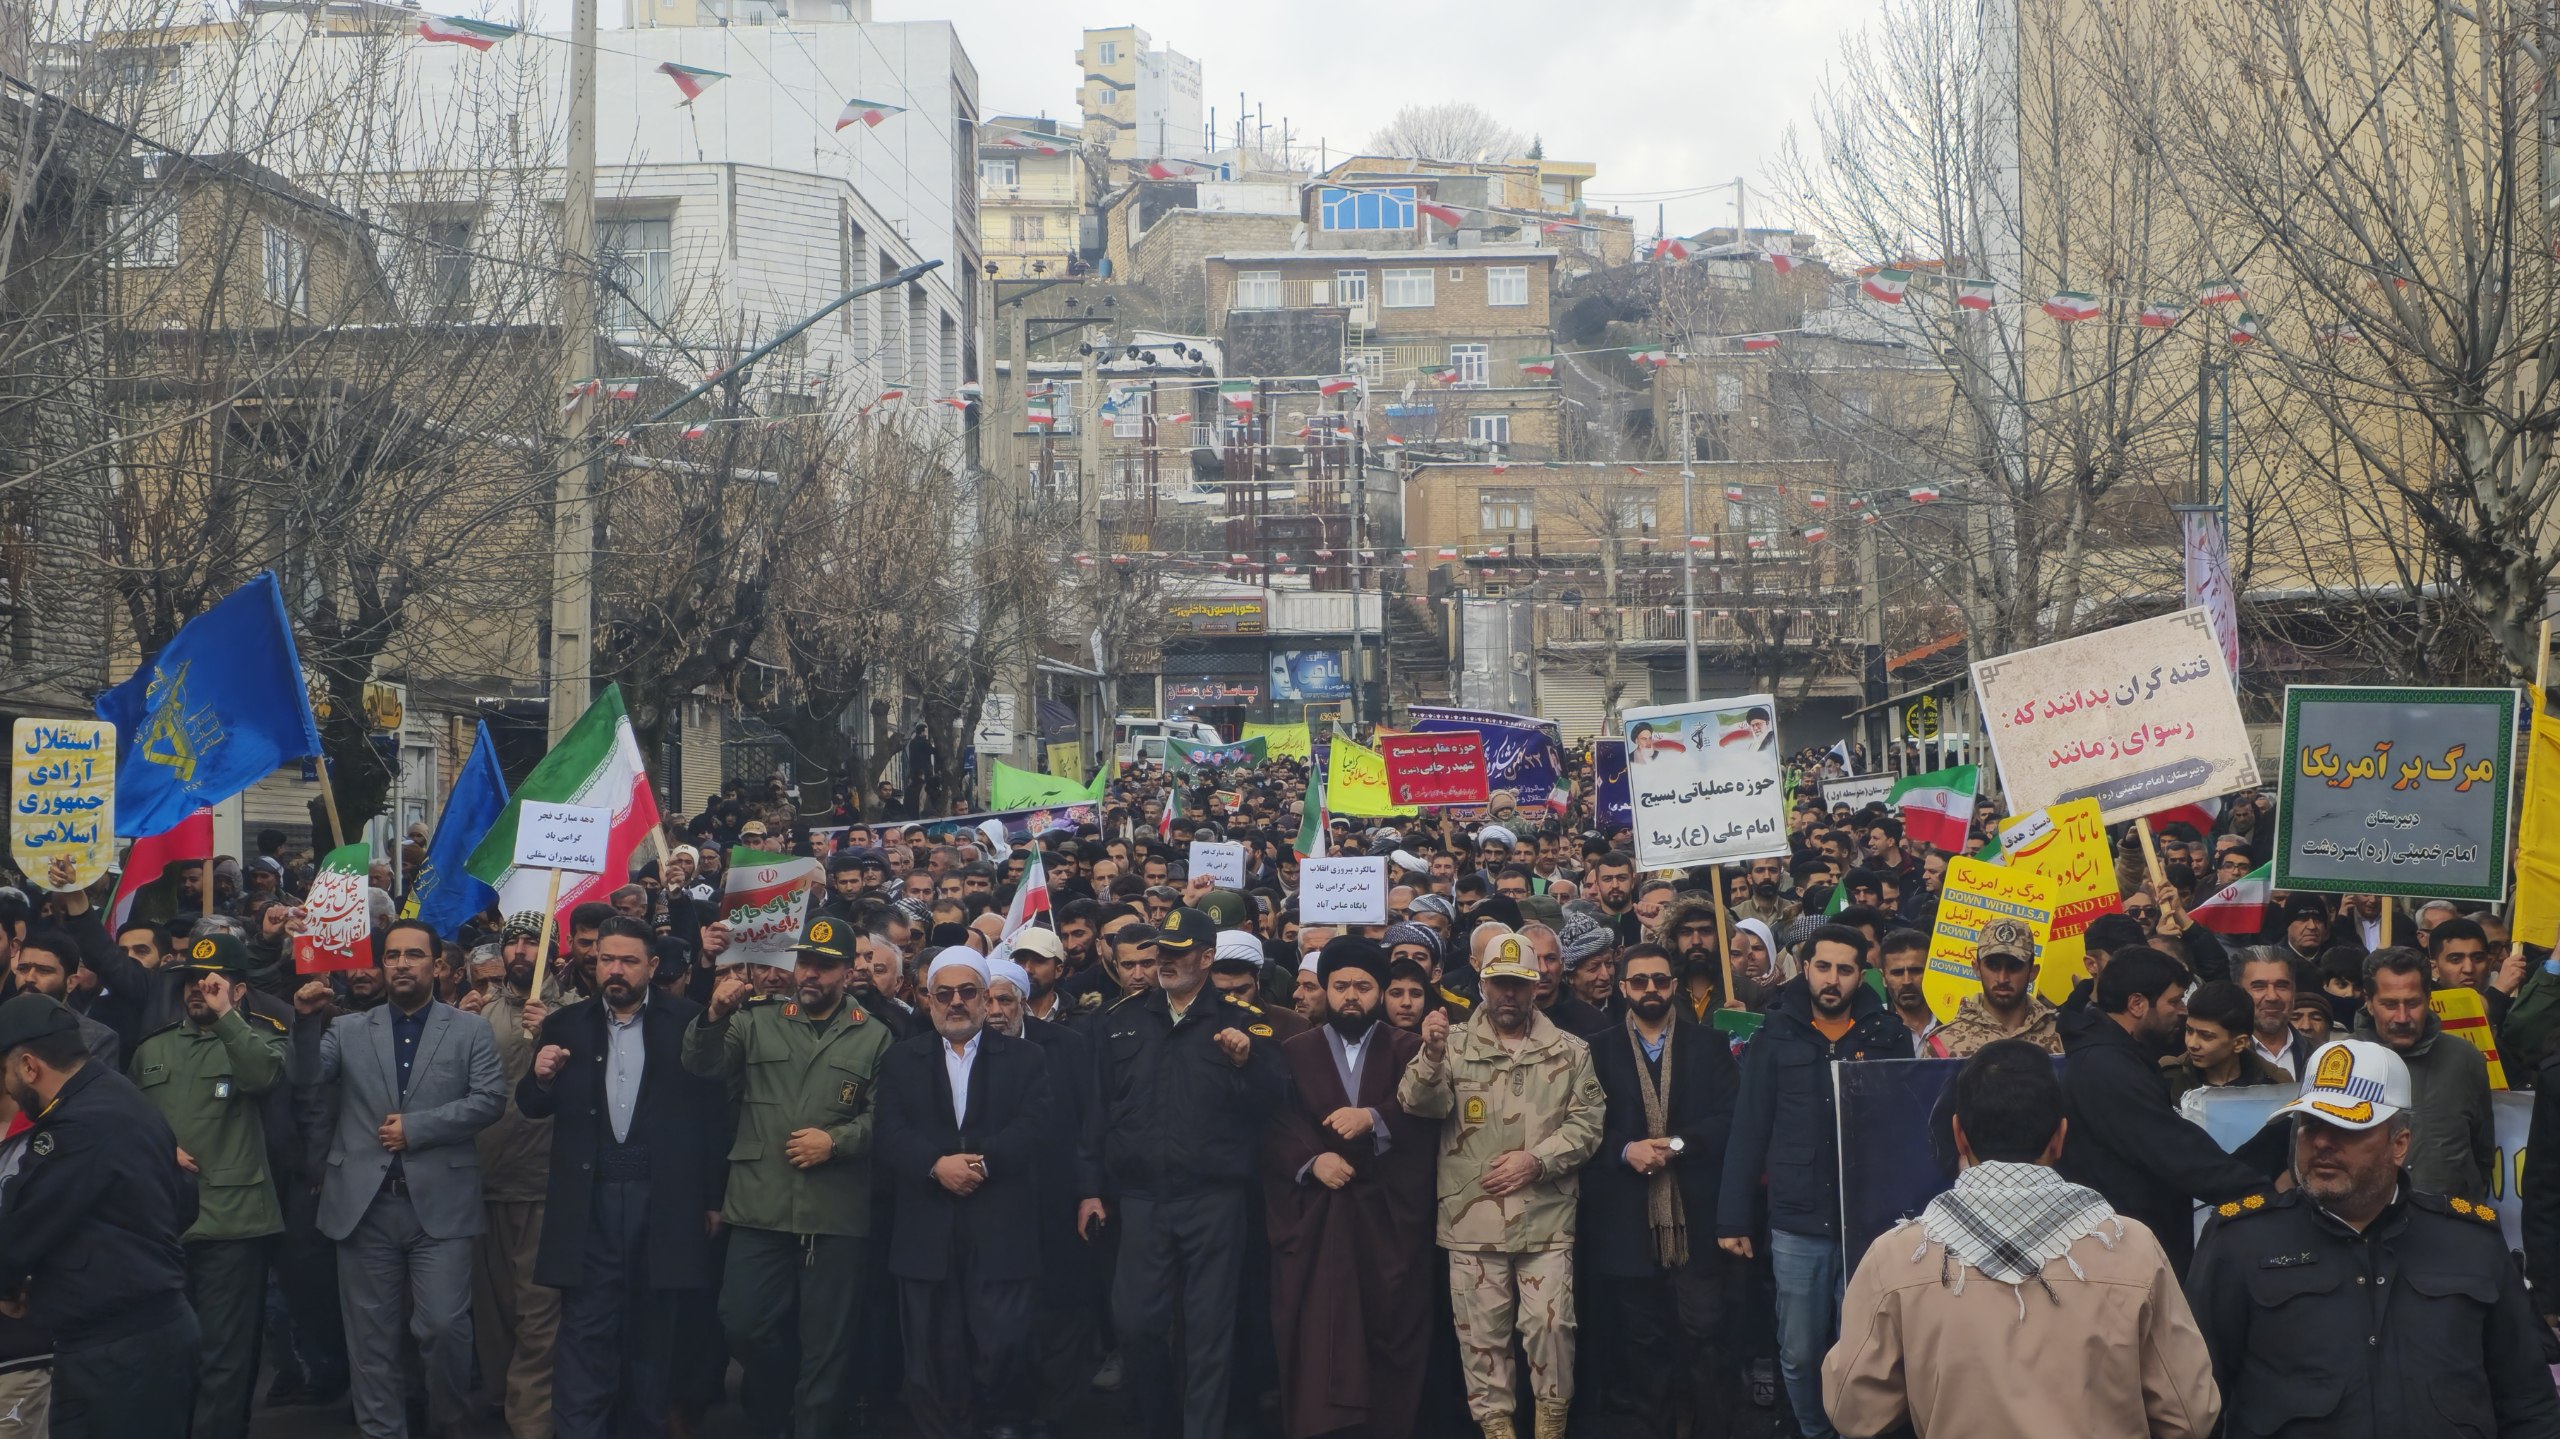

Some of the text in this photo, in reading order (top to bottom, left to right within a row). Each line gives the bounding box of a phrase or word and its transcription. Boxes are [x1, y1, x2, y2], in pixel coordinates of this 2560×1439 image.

[1207, 603, 1261, 617] دکوراسیون
[2169, 653, 2212, 686] فتنه
[1167, 683, 1214, 701] کردستان
[2114, 666, 2163, 706] گران
[2044, 688, 2111, 719] بدانند
[24, 725, 100, 755] استقلال
[1416, 743, 1451, 756] مقاومت
[1451, 743, 1477, 755] حوزه
[1392, 746, 1415, 758] بسیج
[28, 758, 95, 788] آزادی
[1420, 761, 1452, 775] رجایی
[1452, 760, 1476, 772] شهید
[2166, 764, 2206, 785] دبیرستان
[2301, 740, 2394, 789] آمریکا
[2391, 755, 2423, 792] بر
[2424, 743, 2495, 793] مرگ
[2115, 782, 2144, 799] خمینی
[2145, 774, 2165, 790] امام
[1640, 777, 1775, 808] حوزه عملیاتی بسیج
[18, 793, 104, 816] جمهوری
[537, 811, 595, 824] دهه مبارک فجر
[2078, 811, 2089, 843] تا
[2365, 809, 2421, 830] دبیرستان
[24, 820, 98, 848] اسلامی
[545, 832, 582, 844] گرامی باد
[1713, 822, 1743, 844] علی
[1746, 817, 1776, 840] امام
[2090, 816, 2099, 841] ما
[2003, 830, 2026, 850] هدف
[526, 850, 547, 861] سفلی
[574, 854, 595, 867] پایگاه
[1200, 849, 1211, 857] فجر
[1211, 849, 1224, 858] مبارک
[2391, 843, 2442, 865] خمینی
[2441, 844, 2478, 867] امام
[1213, 862, 1228, 870] گرامی
[1309, 864, 1376, 875] سالگرد پیروزی انقلاب
[1315, 882, 1370, 892] اسلامی گرامی باد
[1956, 868, 2046, 903] مرگ بر امریکا
[728, 888, 805, 925] تا پای جان
[1315, 899, 1368, 911] پایگاه عباس آباد
[1947, 889, 2046, 922] DOWN WITH U.S.A
[2096, 893, 2118, 913] UP
[734, 915, 800, 944] برای ایران
[1939, 923, 1972, 941] DOWN
[2053, 923, 2083, 940] THE
[1930, 958, 1960, 975] DOWN
